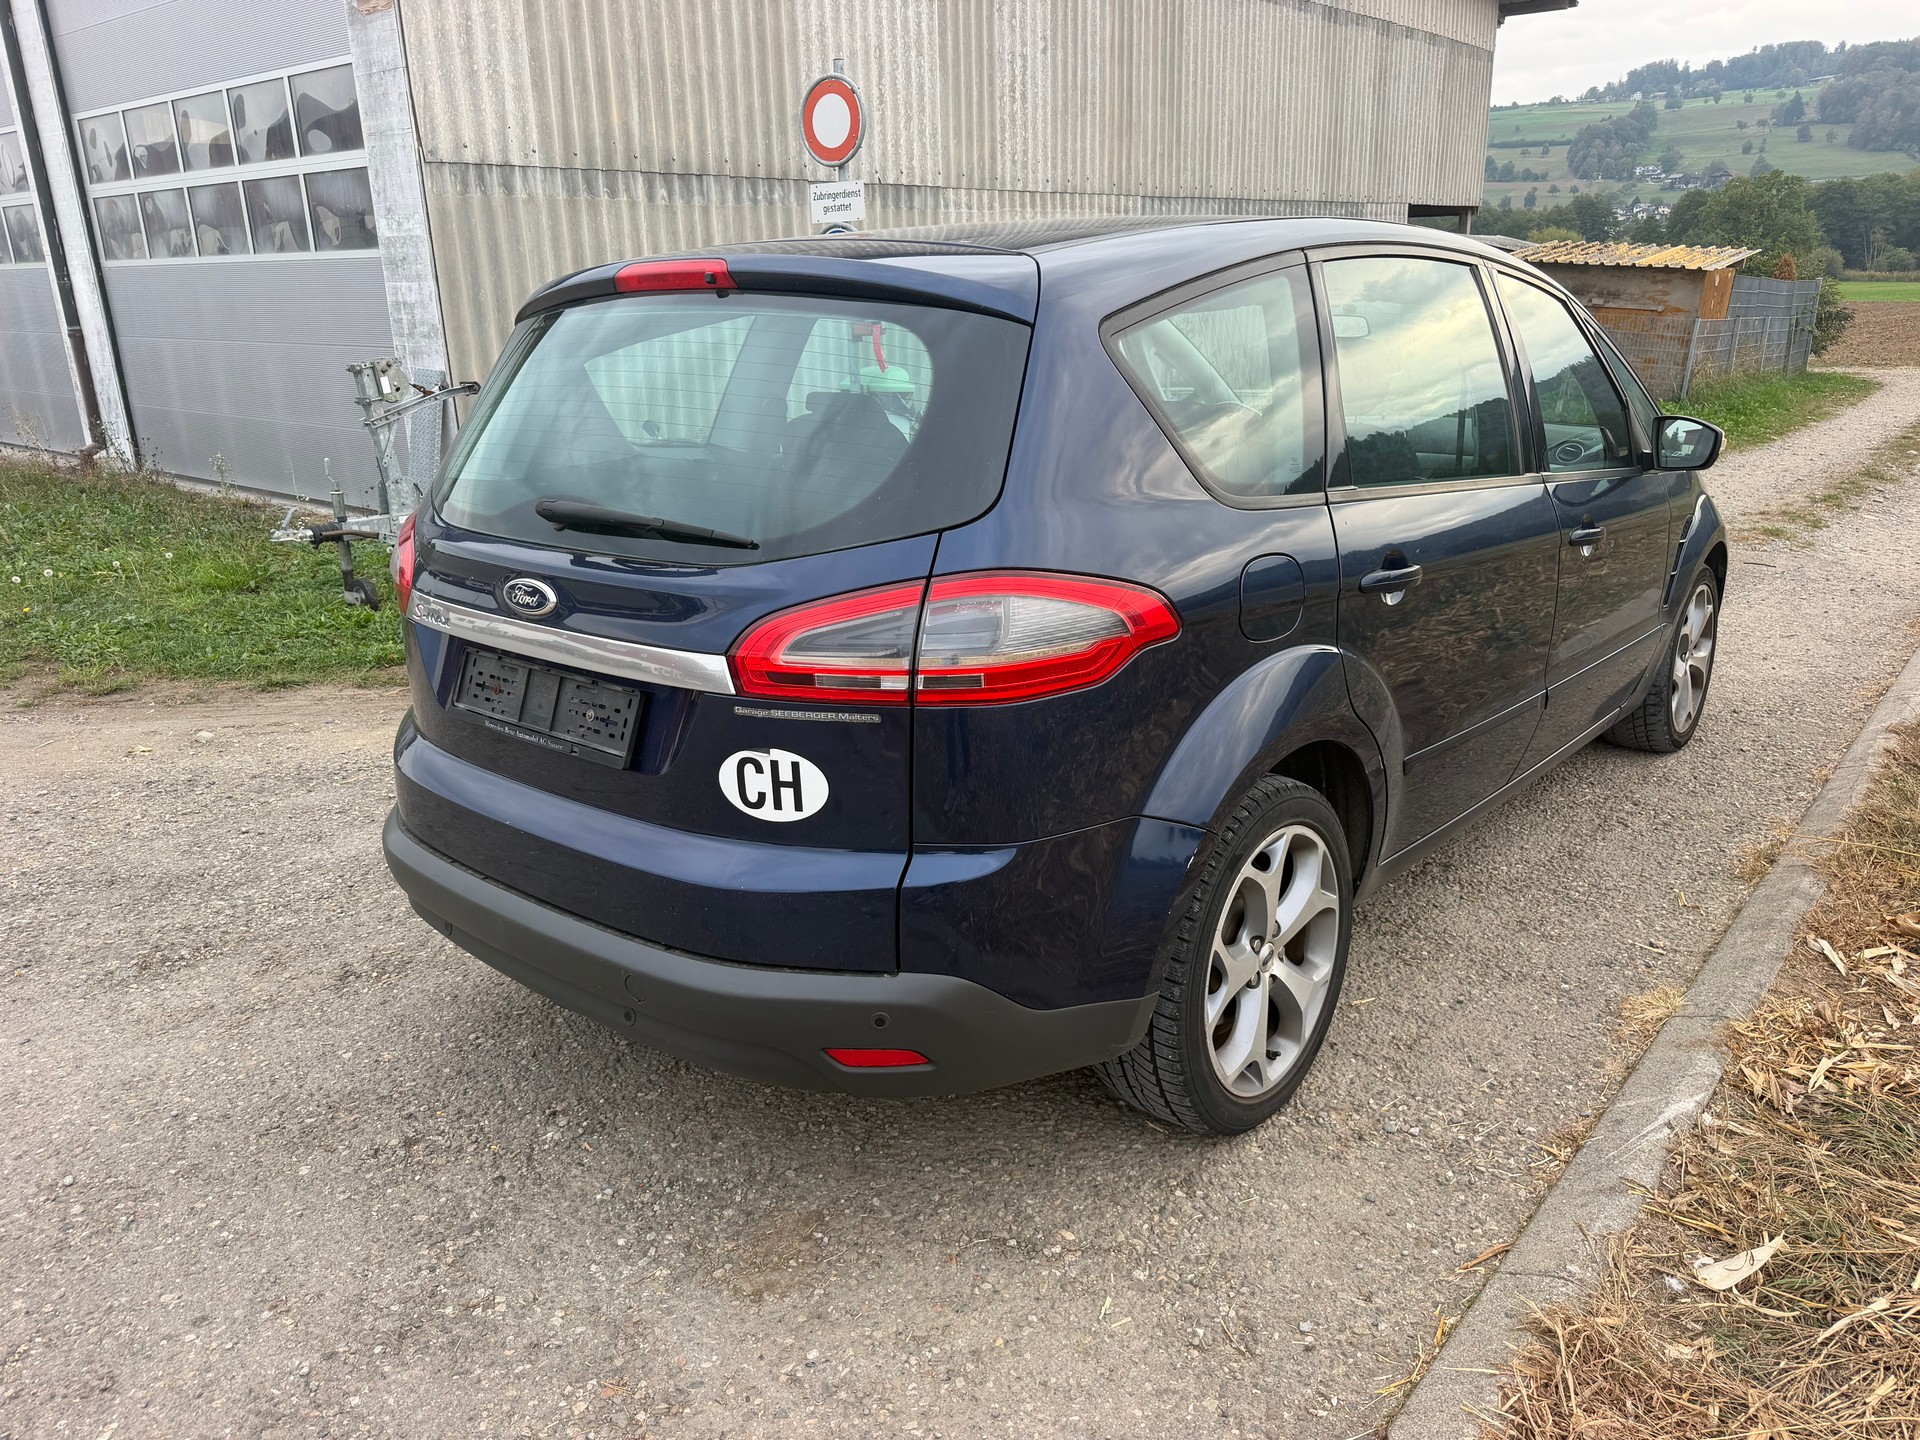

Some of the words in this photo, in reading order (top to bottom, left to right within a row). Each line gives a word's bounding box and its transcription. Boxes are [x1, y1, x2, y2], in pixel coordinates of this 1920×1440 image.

[812, 189, 861, 202] Zubringerdienst
[822, 203, 852, 215] gestattet
[511, 584, 540, 607] Ford
[734, 706, 769, 717] Garage
[770, 709, 836, 720] SEEBERGER
[838, 713, 880, 722] Malters
[736, 756, 804, 813] CH
